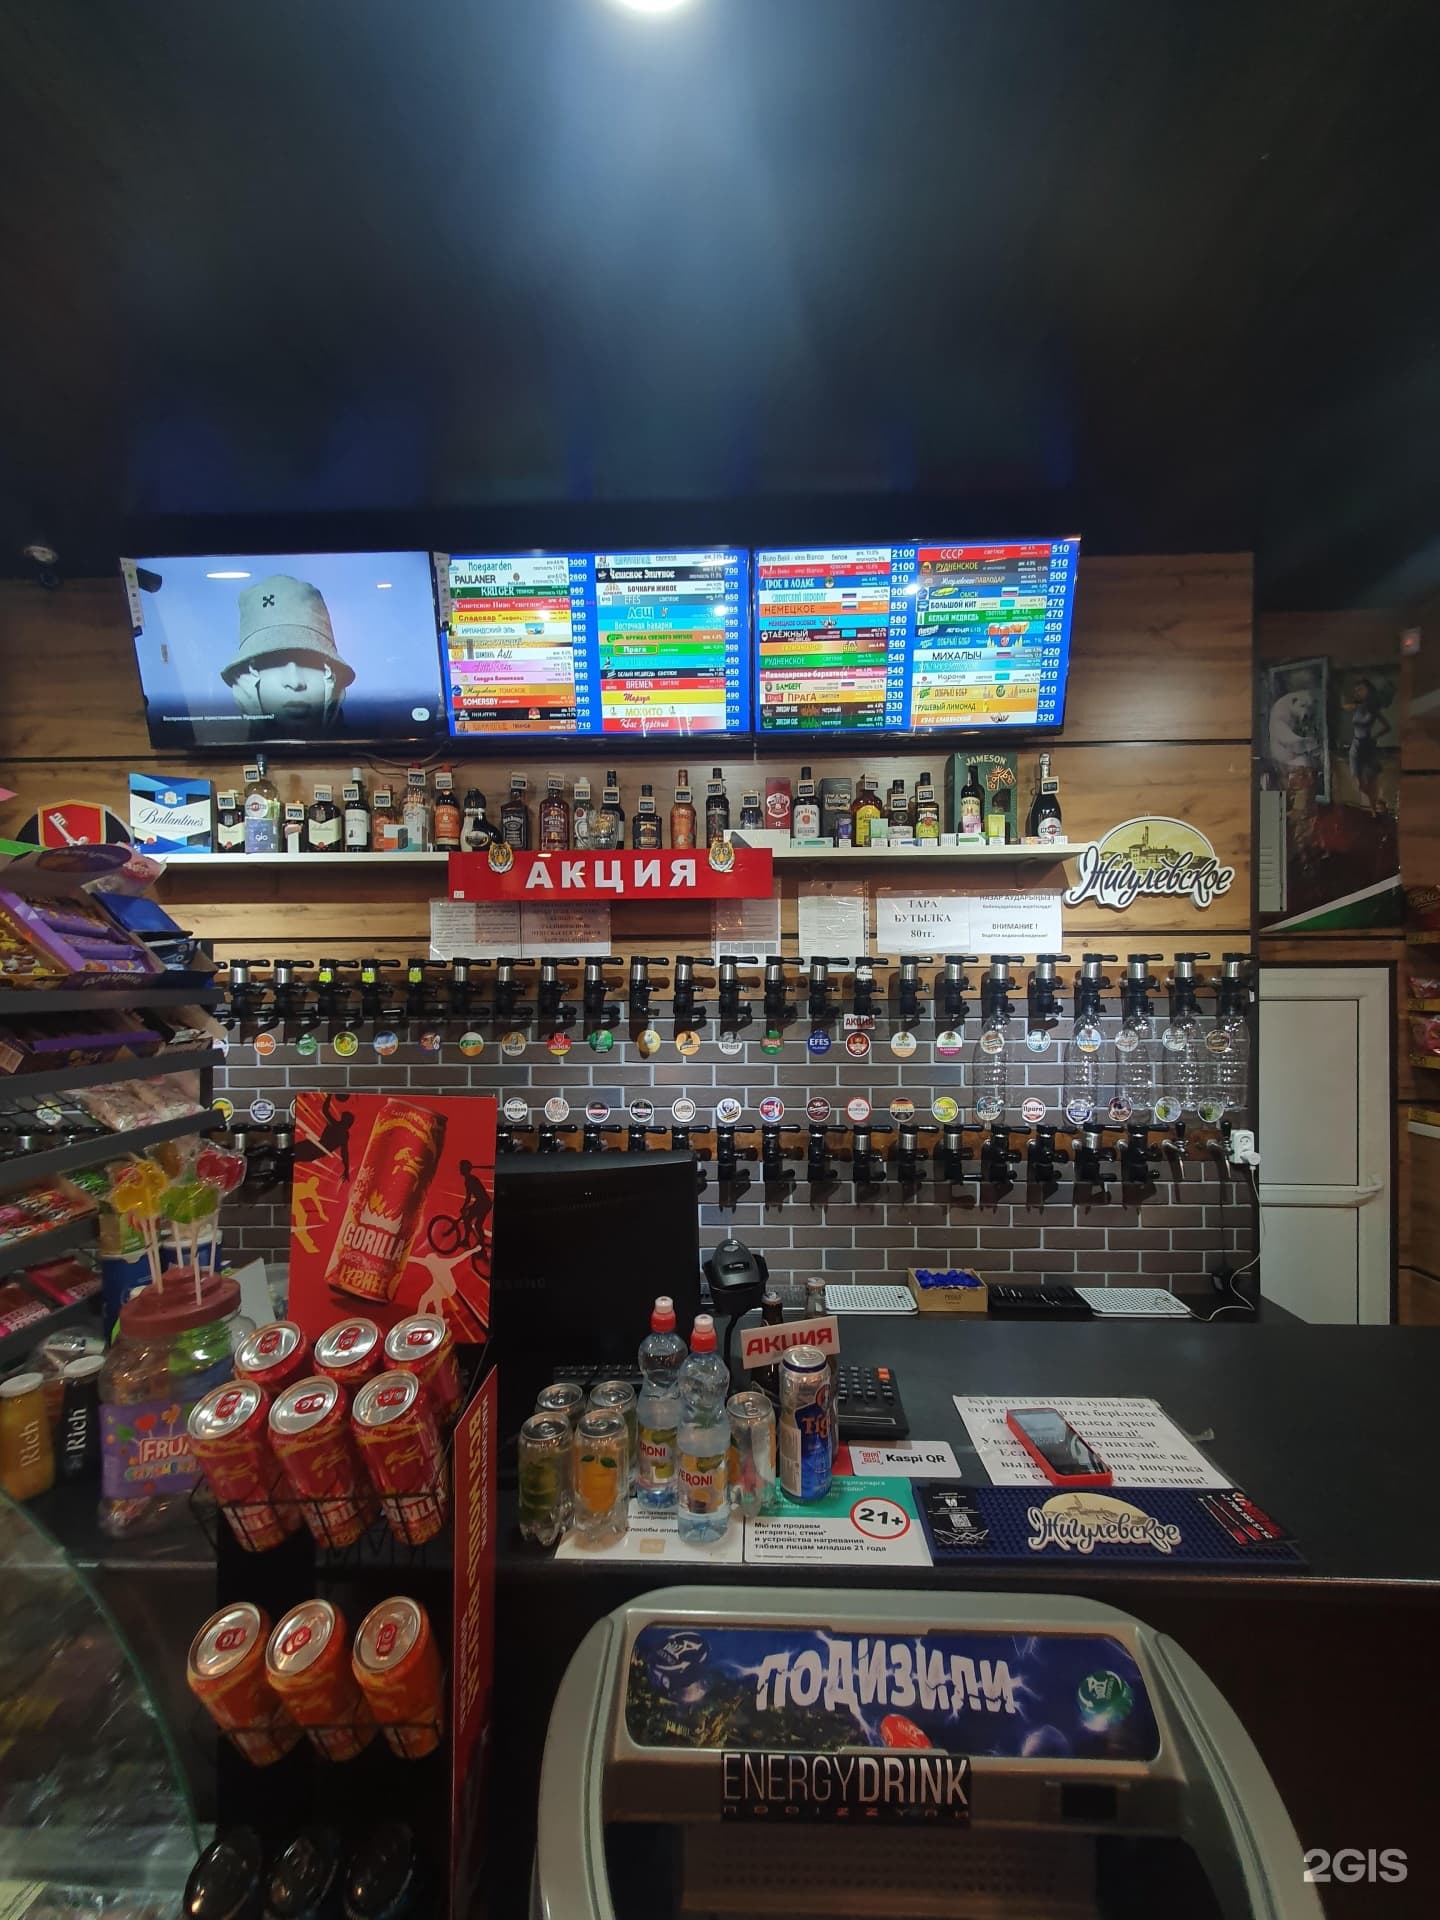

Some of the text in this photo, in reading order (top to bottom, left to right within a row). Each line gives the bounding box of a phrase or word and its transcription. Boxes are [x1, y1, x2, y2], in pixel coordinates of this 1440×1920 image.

[892, 549, 914, 557] 2100
[1052, 545, 1069, 553] 510
[941, 549, 963, 559] СССР
[569, 559, 587, 567] 3000
[892, 562, 914, 570] 2100
[936, 562, 978, 570] РУДНЕНСКОЕ
[1051, 559, 1068, 567] 510
[455, 575, 496, 584] PAULANER
[1050, 572, 1067, 580] 500
[765, 579, 815, 589] ТРОЕ В ЛОДКЕ
[624, 595, 641, 604] EFES
[1047, 599, 1064, 607] 470
[764, 605, 815, 614] НЕМЕЦКОЕ
[931, 601, 962, 609] БОЛЬШОЙ
[1046, 610, 1063, 618] 470
[932, 651, 982, 660] МИХАЛЫЧ
[1043, 648, 1060, 656] 420
[764, 657, 805, 665] РУДНЕНСКОЕ
[626, 681, 653, 689] BREMEN
[788, 693, 816, 701] ПРАГА
[915, 703, 976, 712] ГРУШЕВЫЙ ЛИМОНАД
[1039, 700, 1055, 708] 320
[625, 708, 663, 716] МОХИТО
[1038, 714, 1054, 722] 320
[965, 753, 1007, 766] JAMESON
[255, 832, 268, 842] glo
[525, 859, 696, 893] АКЦИЯ
[1069, 845, 1230, 904] Жигулевское
[909, 900, 938, 908] ТАРА
[894, 913, 951, 923] БУТЫЛКА
[846, 1018, 874, 1027] АКЦИЯ
[342, 1220, 405, 1261] GORILLA
[745, 1327, 833, 1356] АКЦИЯ
[66, 1407, 87, 1452] Rich
[20, 1420, 41, 1467] Rich
[886, 1453, 946, 1464] Kaspi QR
[1106, 1453, 1168, 1461] покупке
[1139, 1465, 1205, 1474] покупка
[858, 1507, 904, 1526] 21+
[1029, 1506, 1179, 1551] Жигулевское
[755, 1637, 1016, 1714] ПОДИЗИЛИ
[722, 1752, 969, 1806] ENERGYDRINK
